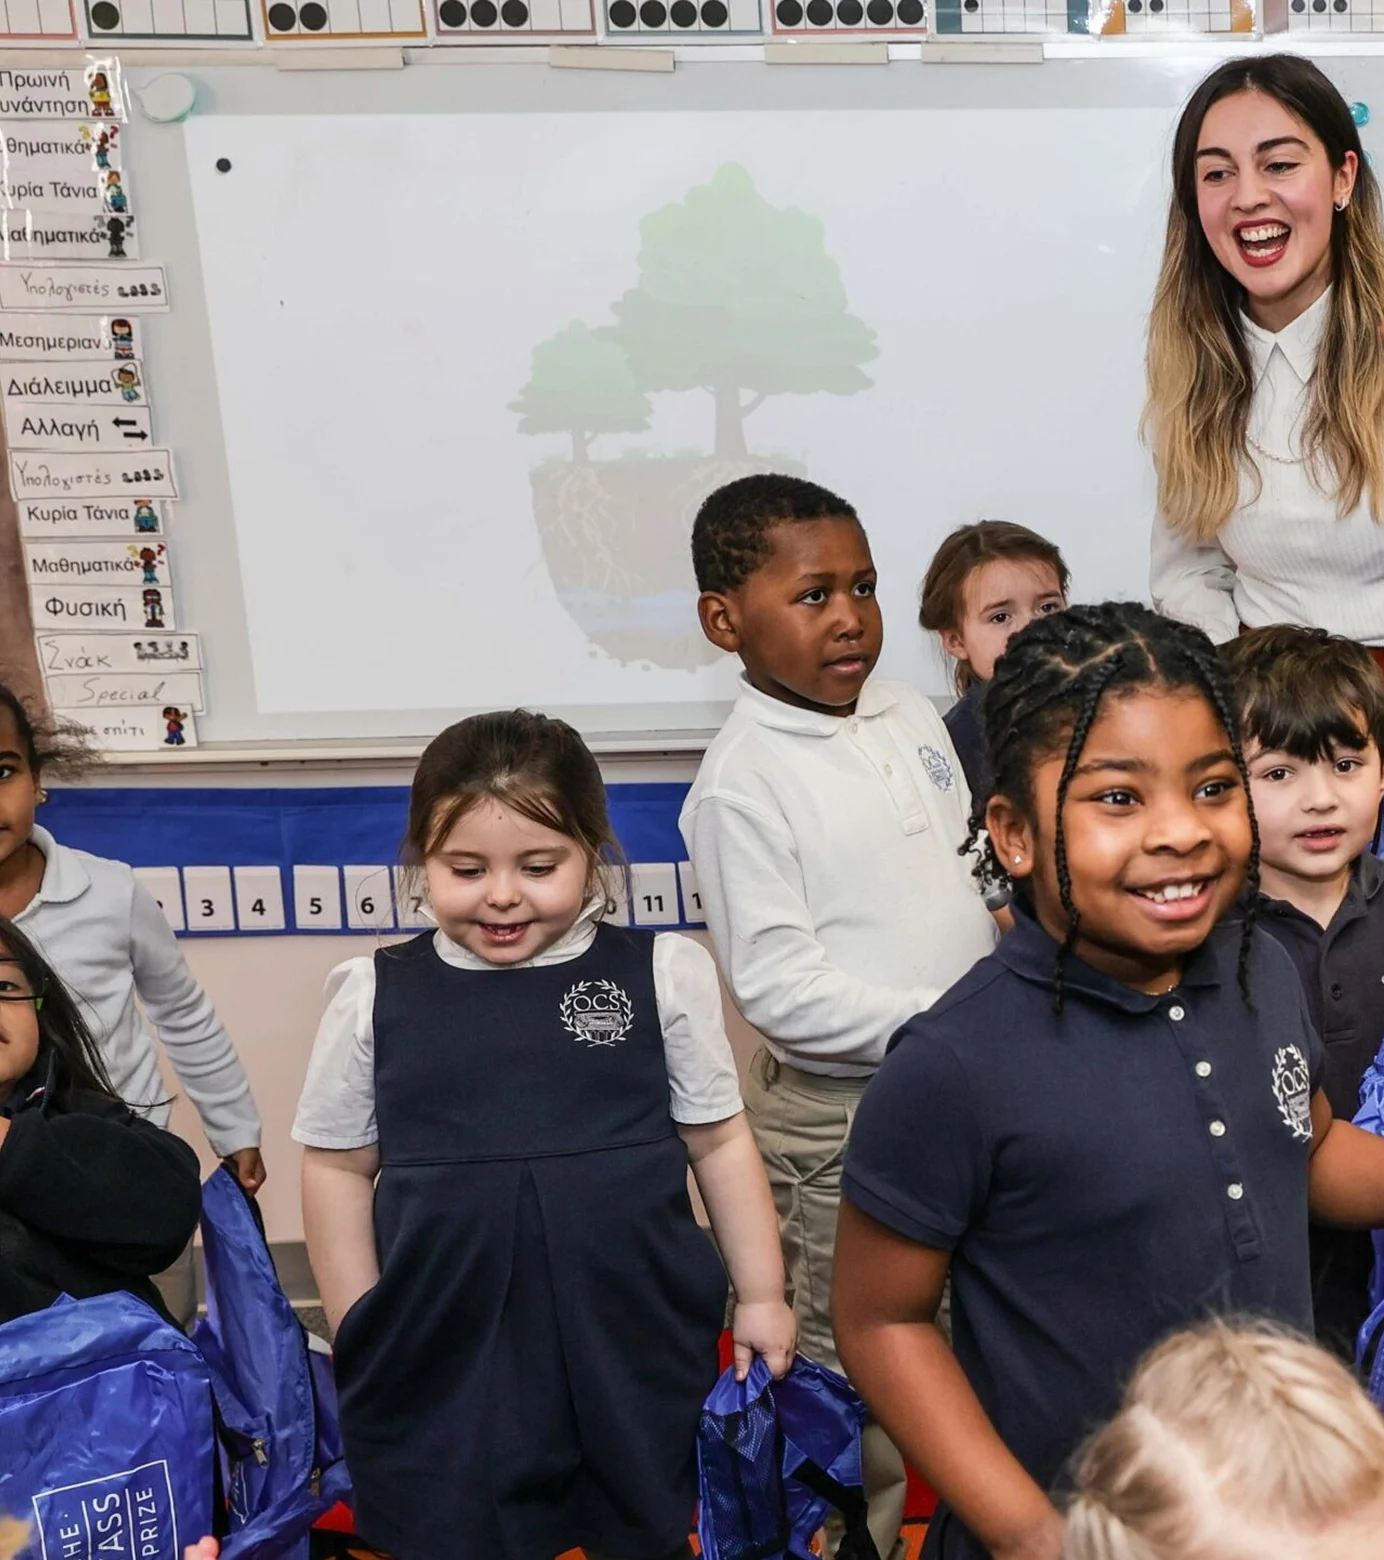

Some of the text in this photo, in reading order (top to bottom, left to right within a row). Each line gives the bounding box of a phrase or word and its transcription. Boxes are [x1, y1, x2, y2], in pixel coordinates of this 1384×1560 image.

[0, 70, 70, 92] Πρωινή
[0, 96, 89, 117] υνάντηση
[5, 137, 86, 157] θηματικά
[49, 181, 98, 198] Τάνια
[7, 377, 112, 398] Διάλειμμα
[21, 417, 100, 441] Αλλαγή
[26, 505, 130, 524] Κυρία Τάνια
[32, 557, 134, 576] Μαθηματικά
[45, 596, 127, 621] Φυσική
[76, 676, 166, 706] Special
[201, 899, 215, 917] 3
[251, 899, 266, 916] 4
[309, 898, 322, 915] 5
[360, 896, 375, 914] 6
[410, 896, 423, 913] 7
[643, 895, 664, 912] 11
[692, 892, 703, 910] 1
[573, 993, 620, 1011] OCS
[93, 1493, 125, 1560] ASS
[135, 1487, 159, 1557] PRIZE
[60, 1523, 82, 1560] HE
